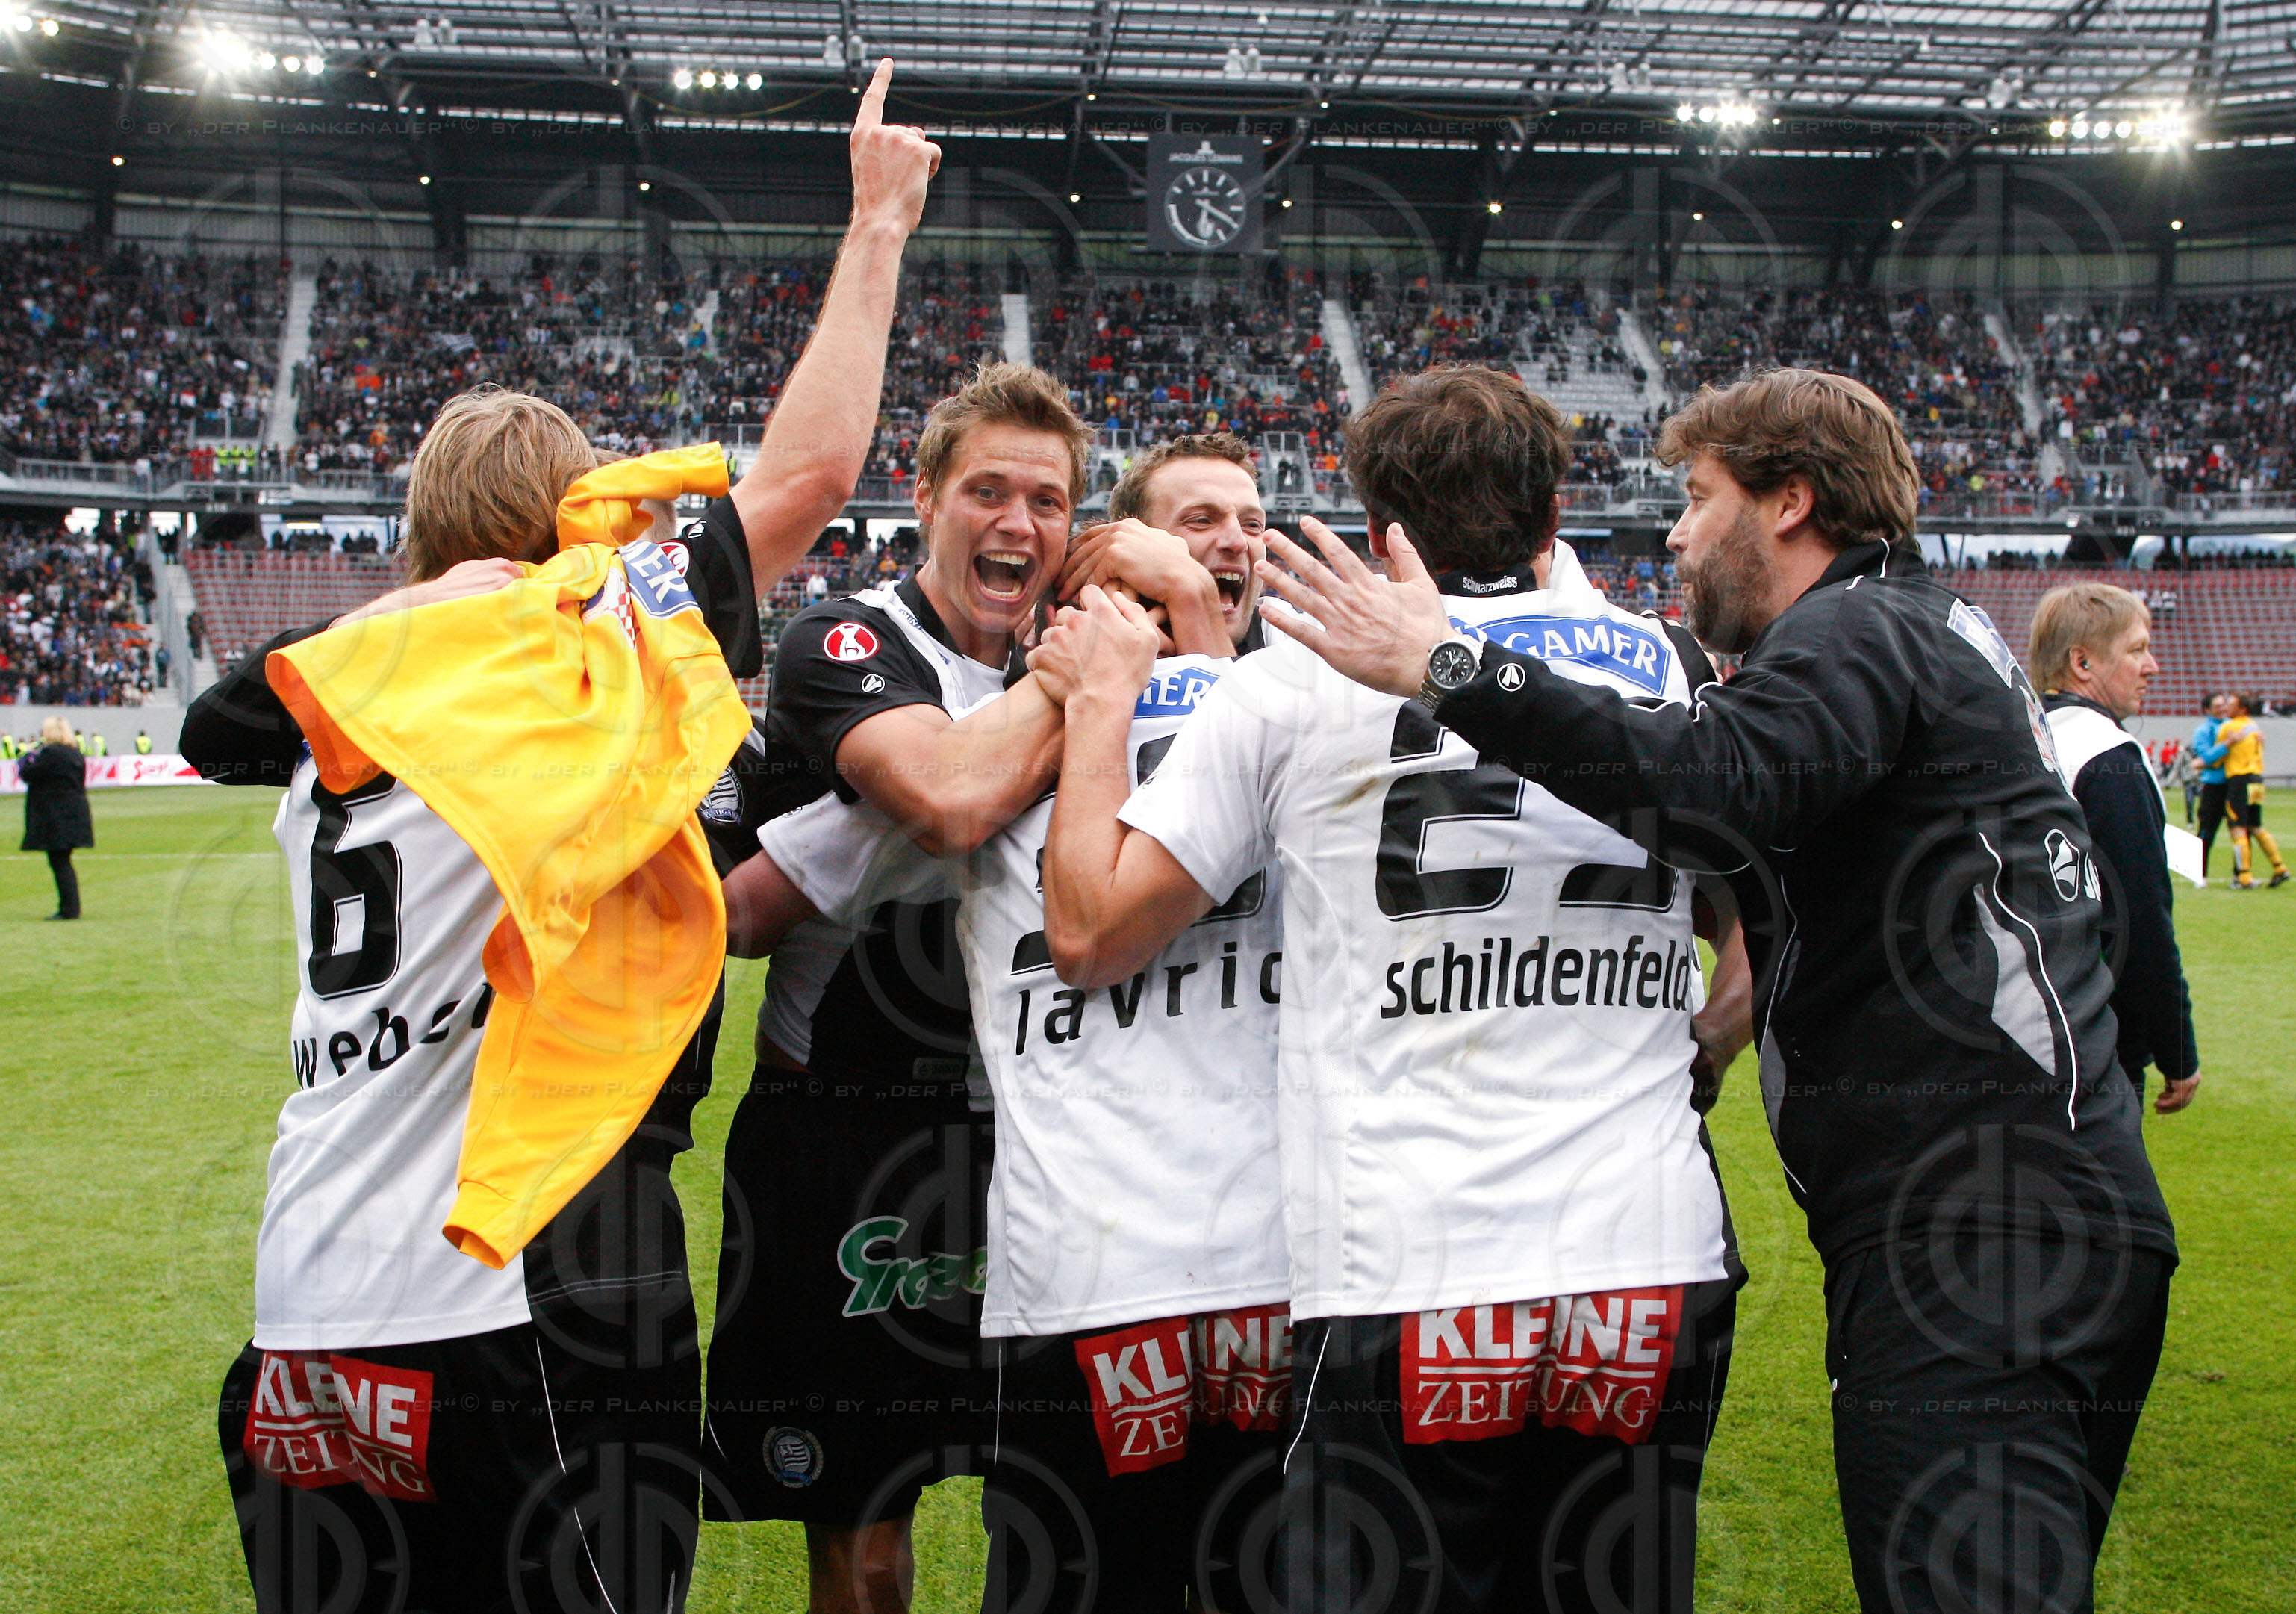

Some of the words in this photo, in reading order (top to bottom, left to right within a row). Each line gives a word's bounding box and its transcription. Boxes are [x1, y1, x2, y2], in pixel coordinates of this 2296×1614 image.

[1463, 576, 1517, 593] schwarzweiss
[308, 771, 404, 1000] 6
[1381, 935, 1689, 1019] schildenfeld
[1419, 1295, 1667, 1364] KLEINE
[255, 1353, 417, 1447] KLENE
